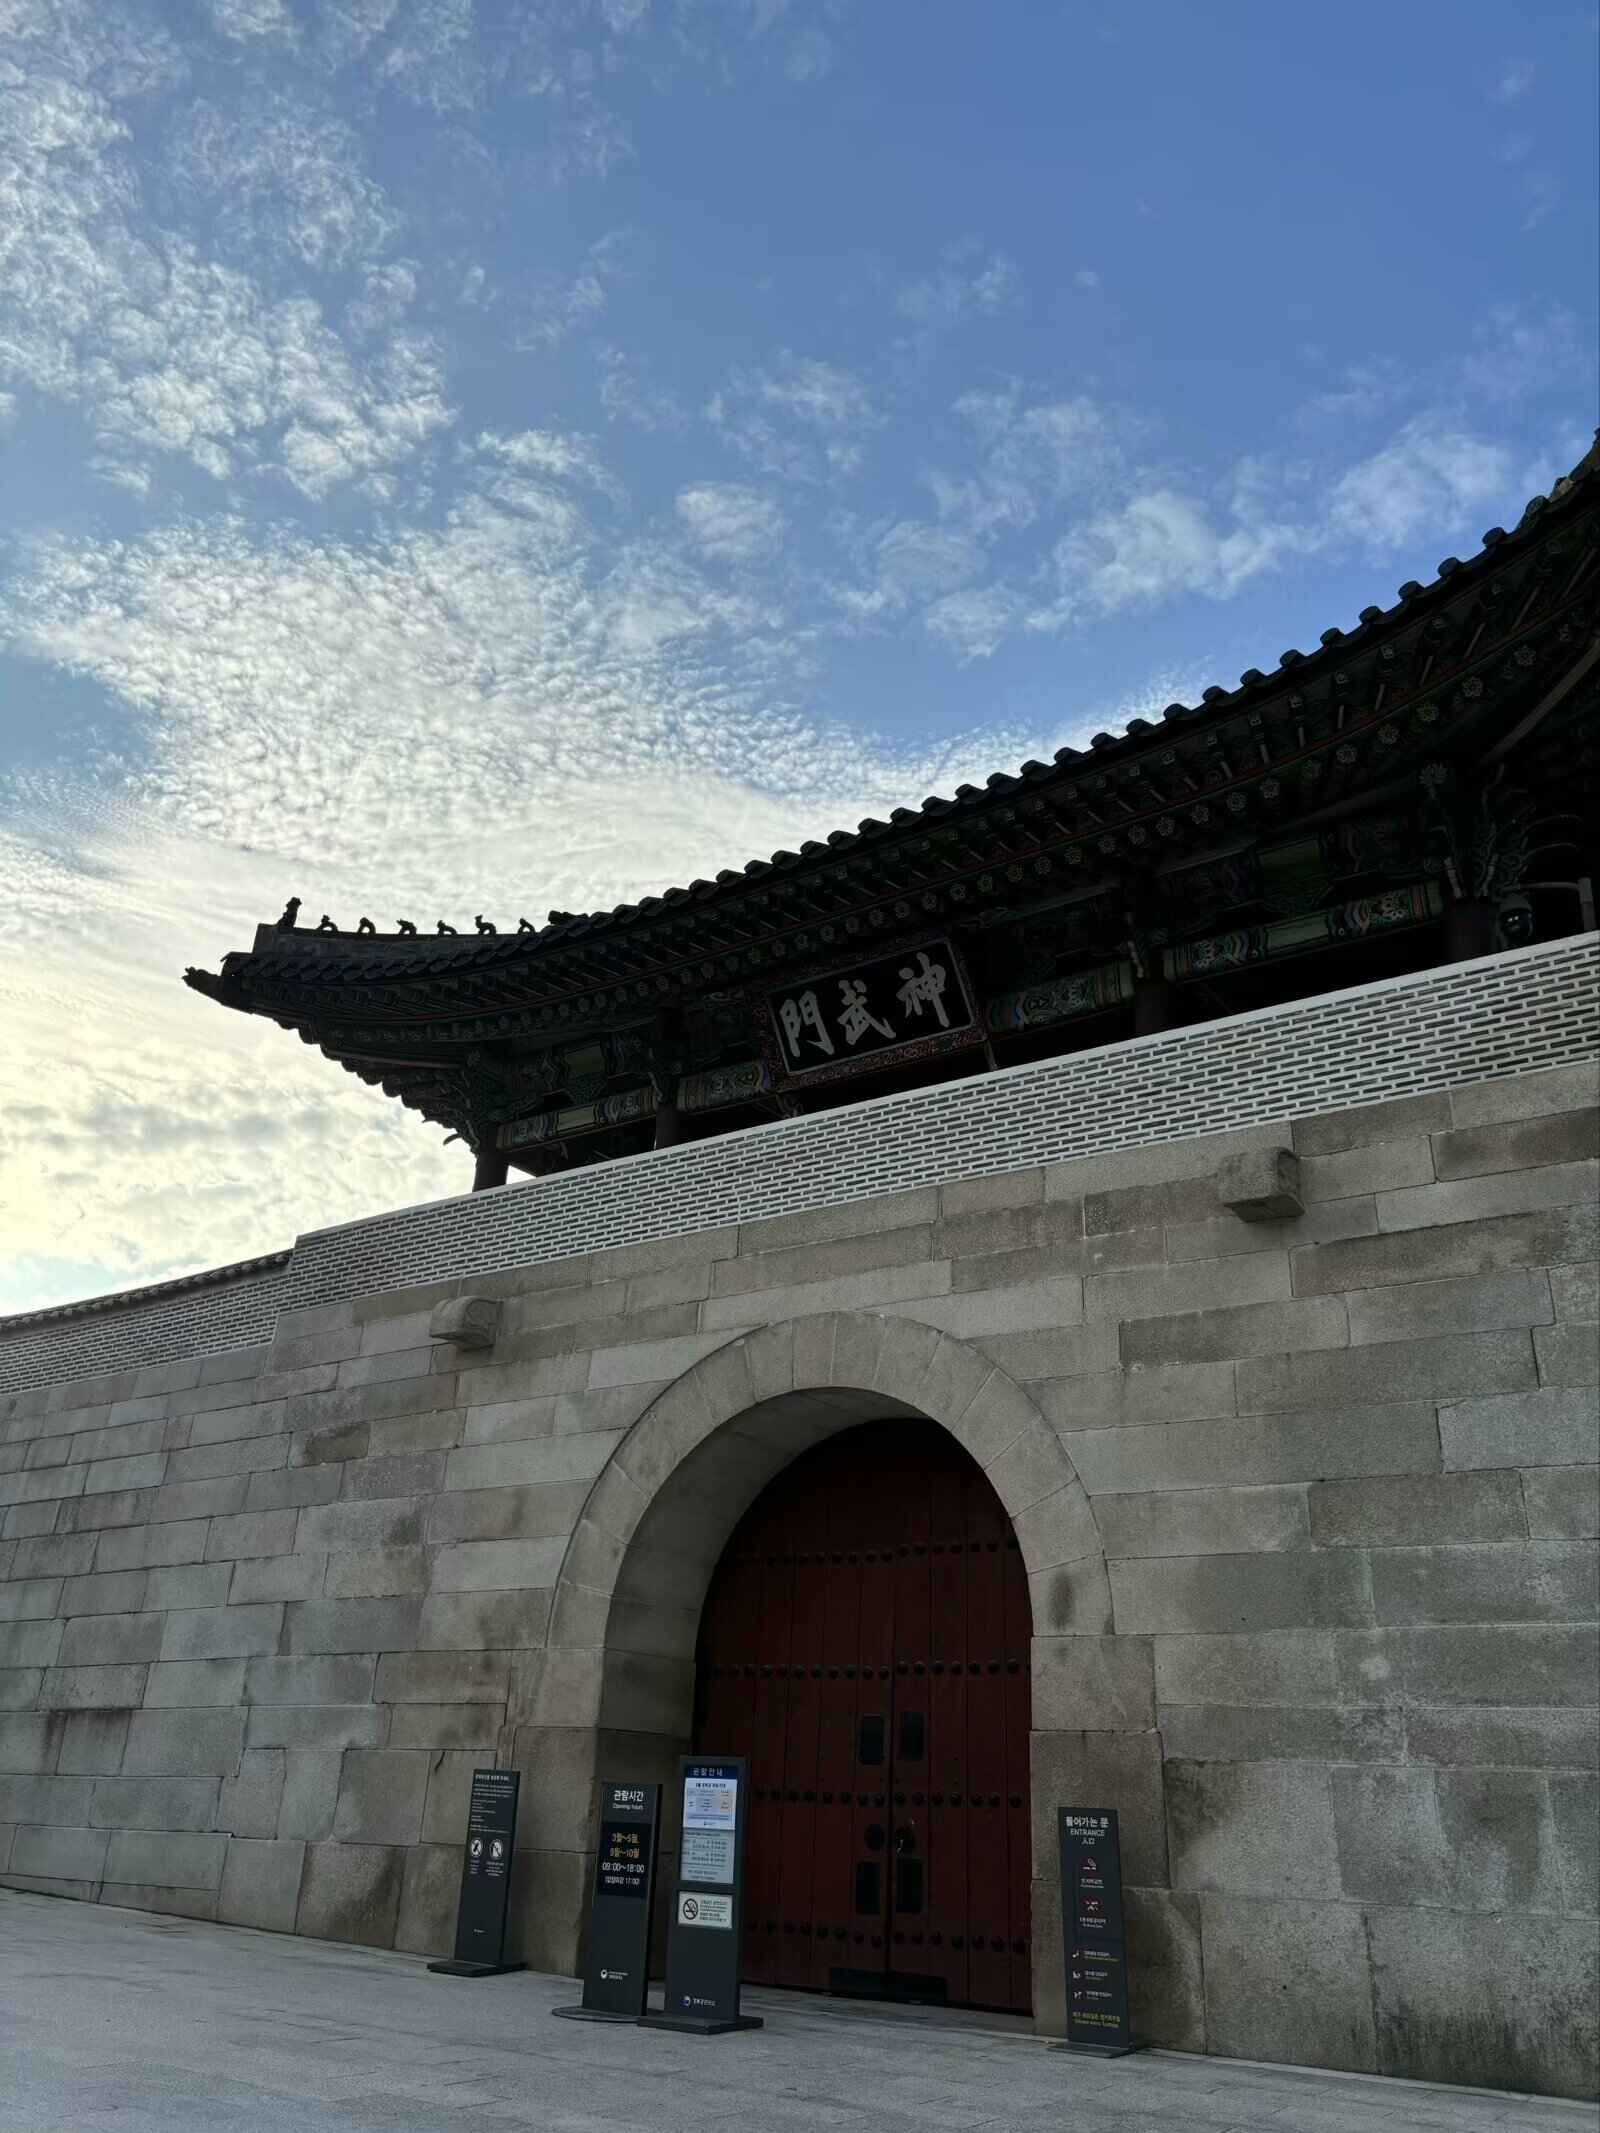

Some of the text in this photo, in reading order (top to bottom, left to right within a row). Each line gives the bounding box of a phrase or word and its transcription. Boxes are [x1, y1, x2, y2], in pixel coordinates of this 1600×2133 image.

[613, 1789, 644, 1802] 관람시간
[1066, 1816, 1110, 1828] 들어가는 문
[1070, 1828, 1105, 1837] ENTRANCE
[1081, 1837, 1095, 1845] 入口
